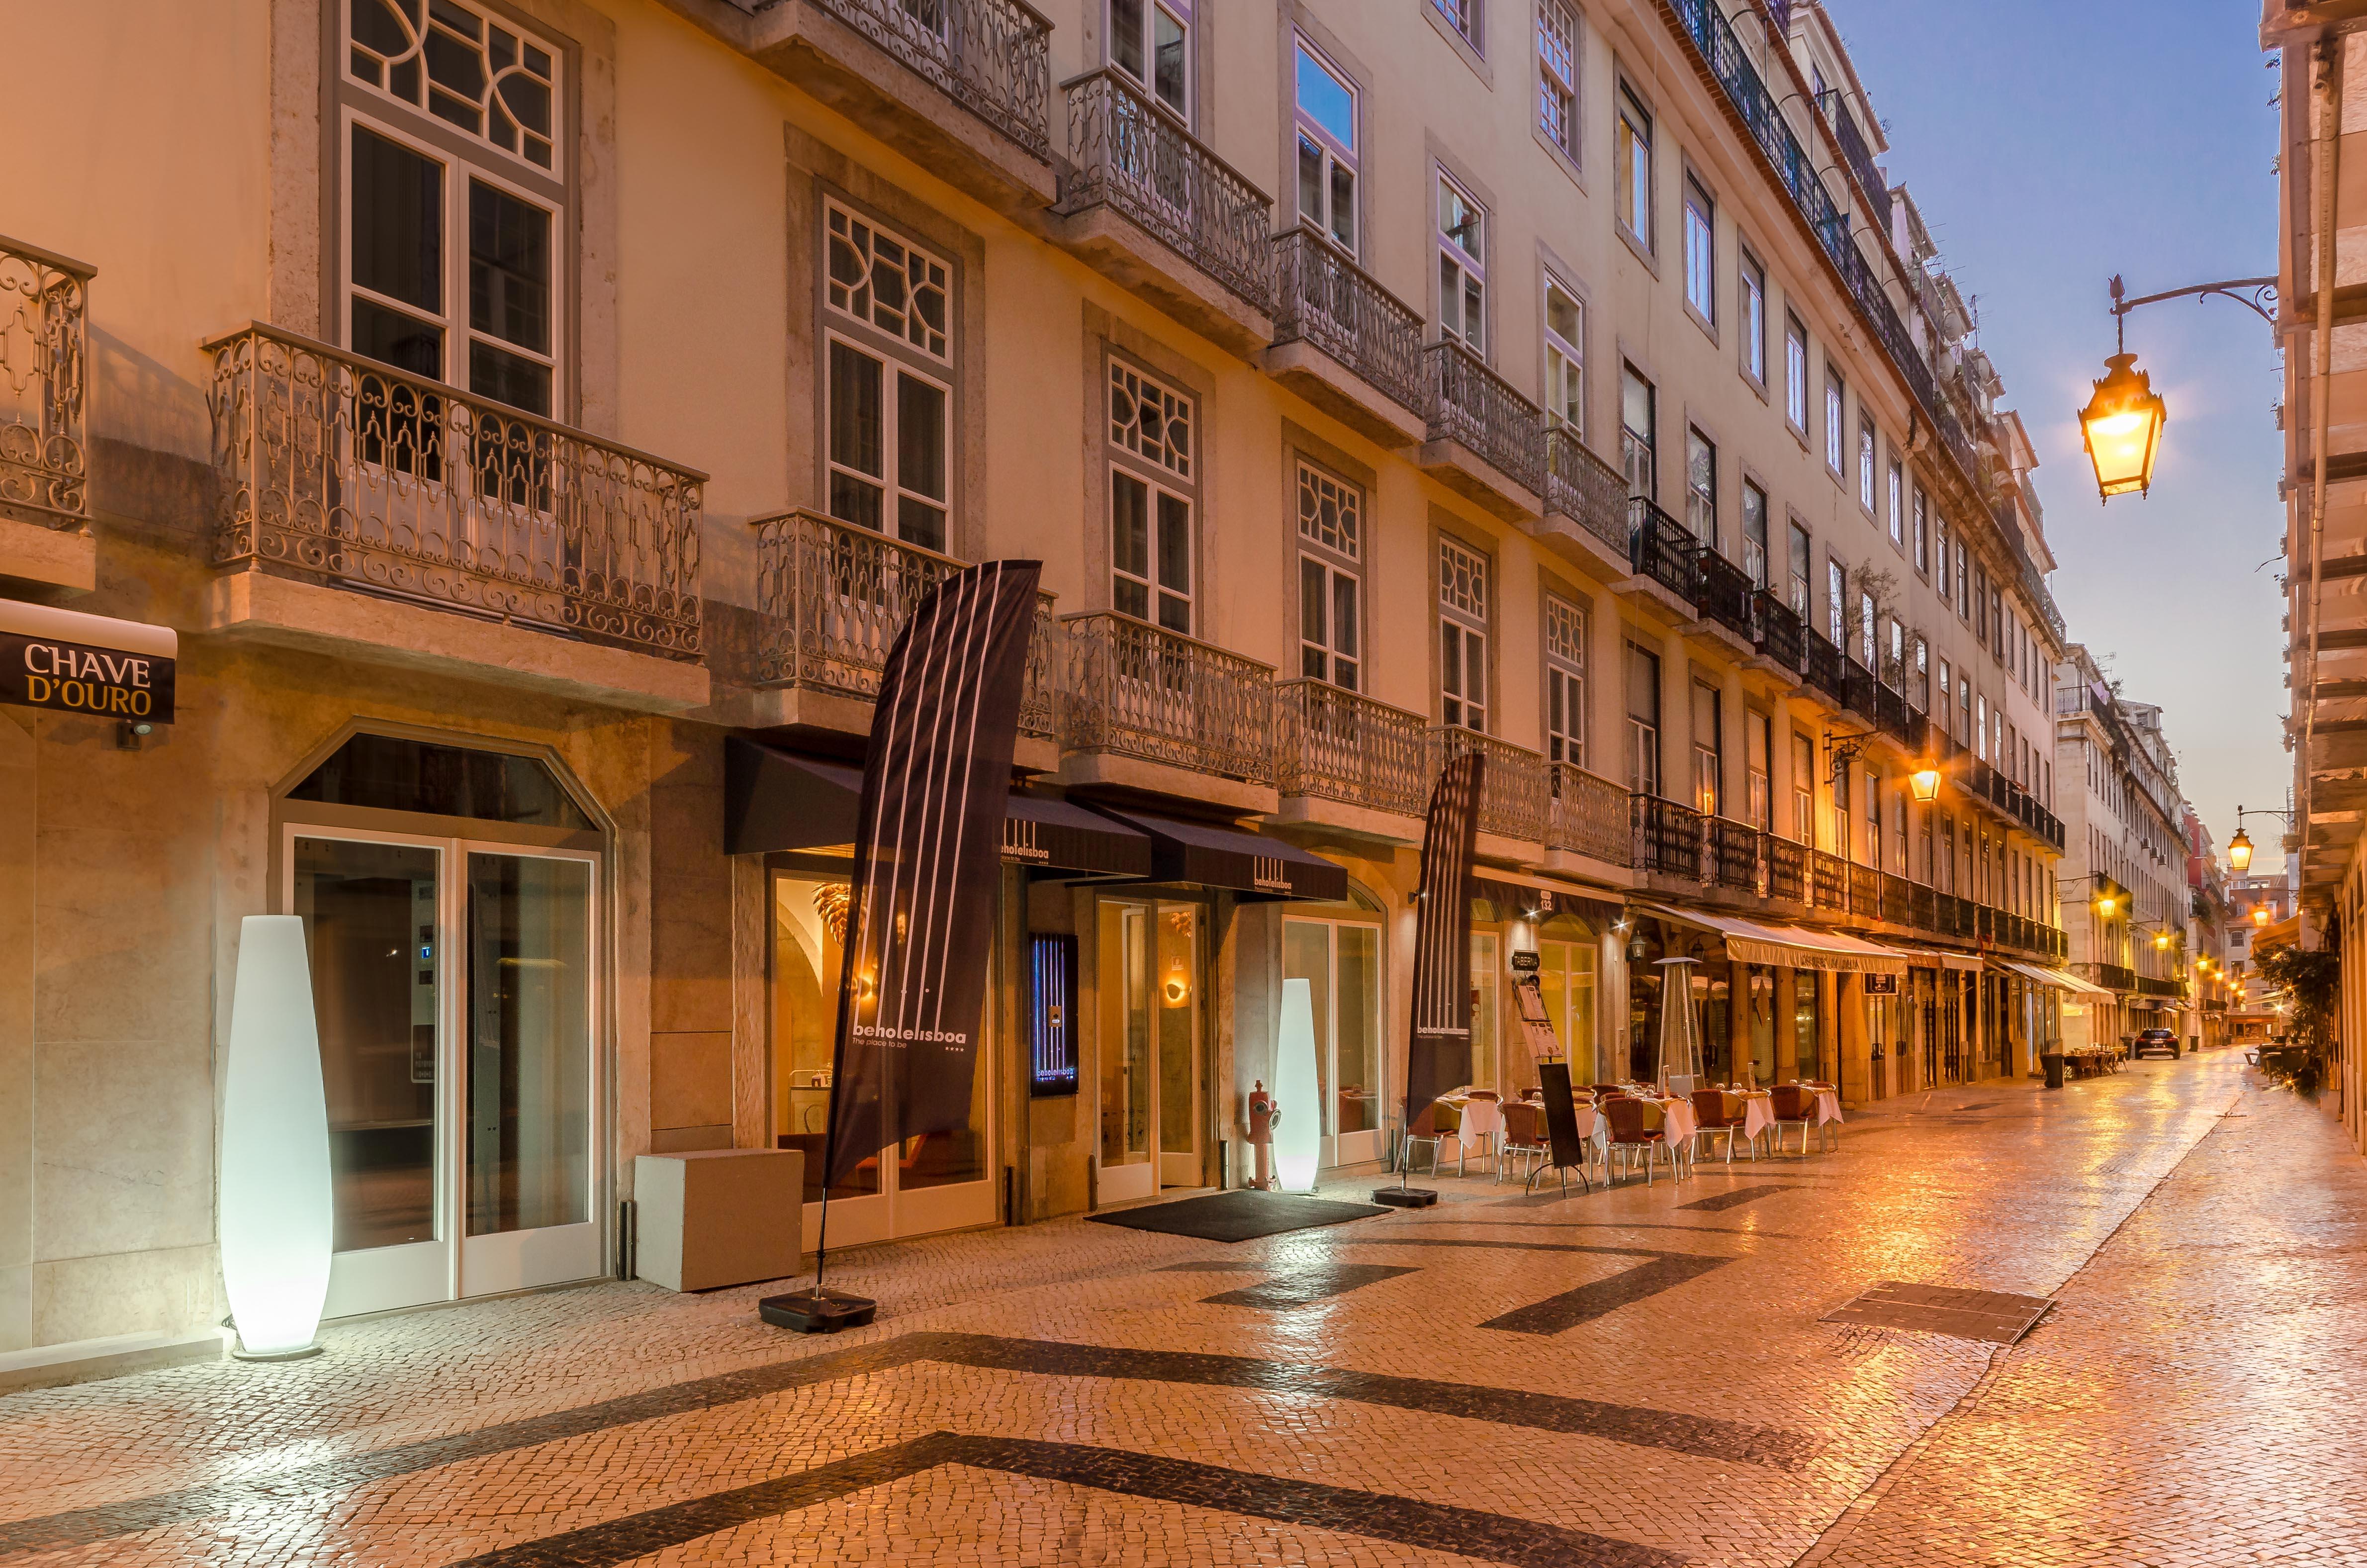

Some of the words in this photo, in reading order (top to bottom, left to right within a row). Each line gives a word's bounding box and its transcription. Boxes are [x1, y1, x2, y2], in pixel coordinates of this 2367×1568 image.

[24, 644, 150, 688] CHAVE
[24, 674, 152, 716] D'OURO
[1541, 900, 1552, 911] 132
[1514, 956, 1538, 966] TABERNA
